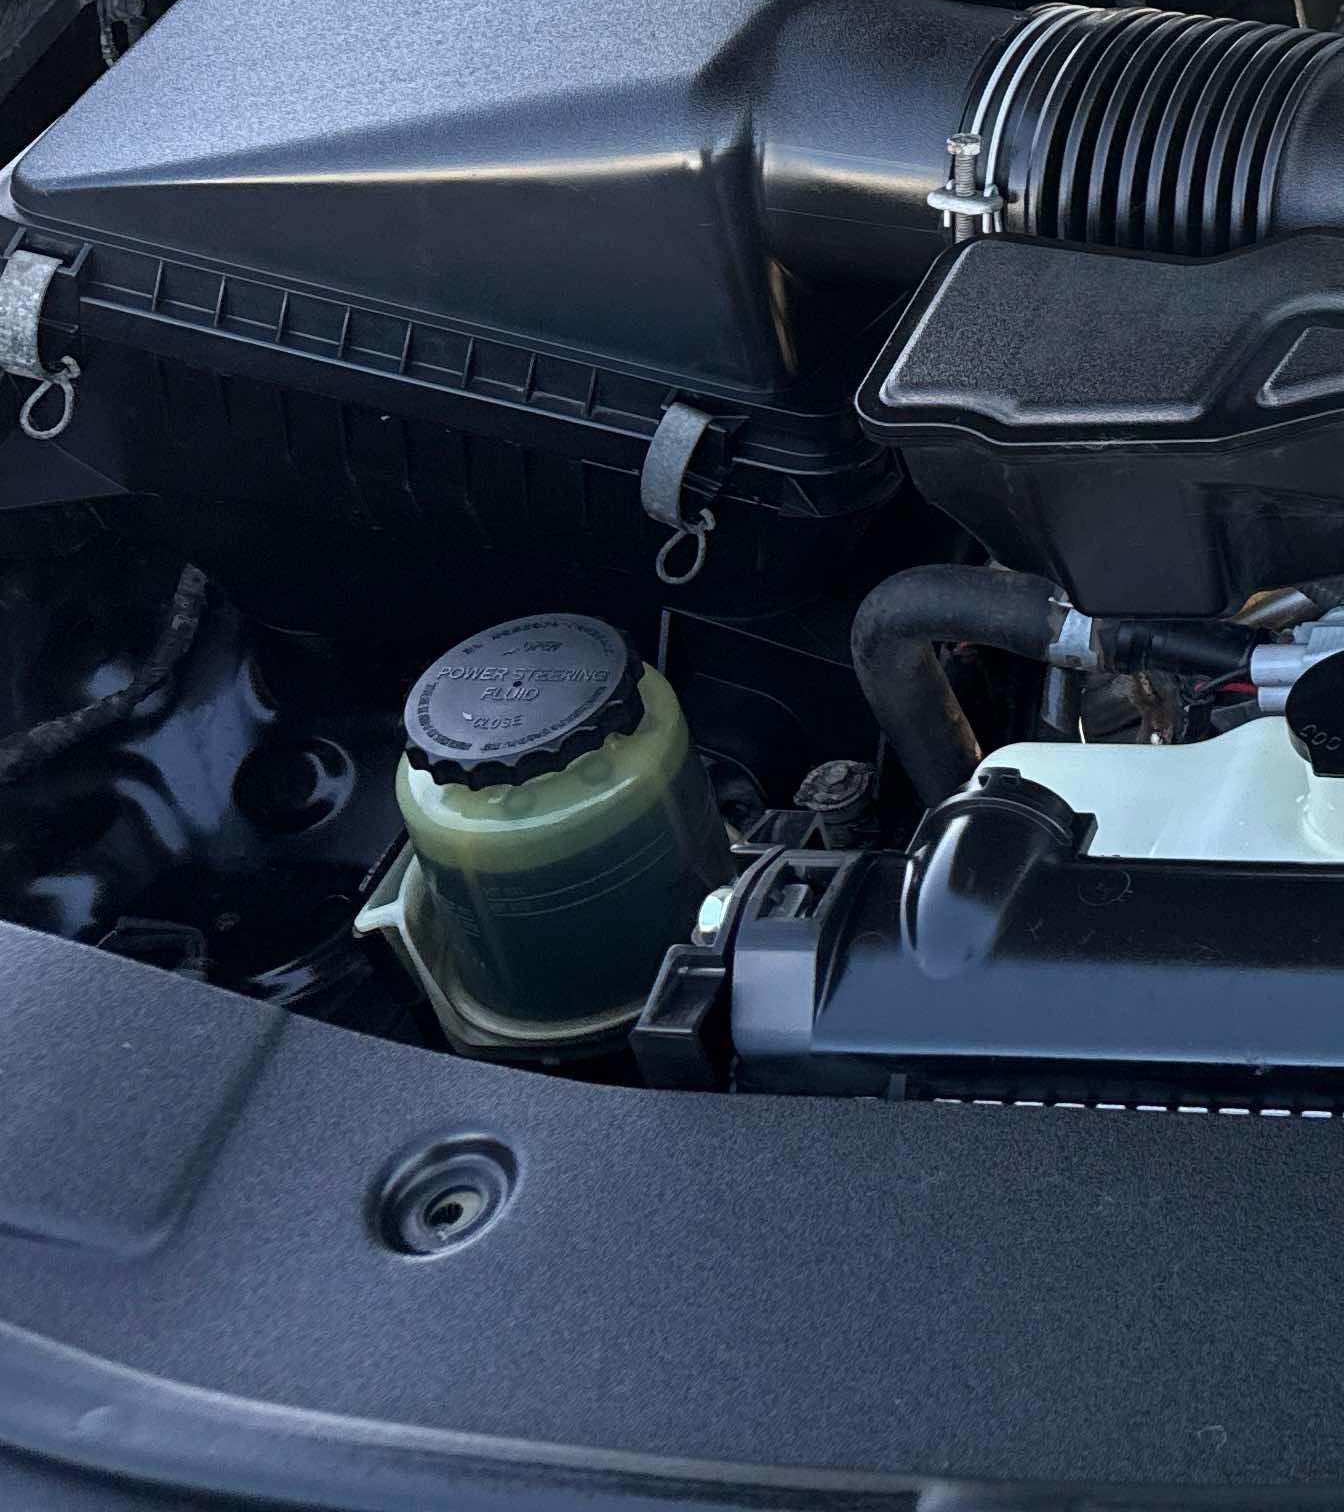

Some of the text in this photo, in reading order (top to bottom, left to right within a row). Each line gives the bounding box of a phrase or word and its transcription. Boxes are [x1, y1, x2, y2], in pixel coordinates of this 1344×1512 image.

[437, 666, 610, 683] POWER STEERING
[480, 687, 541, 703] FLUID
[473, 713, 524, 730] CLOSE
